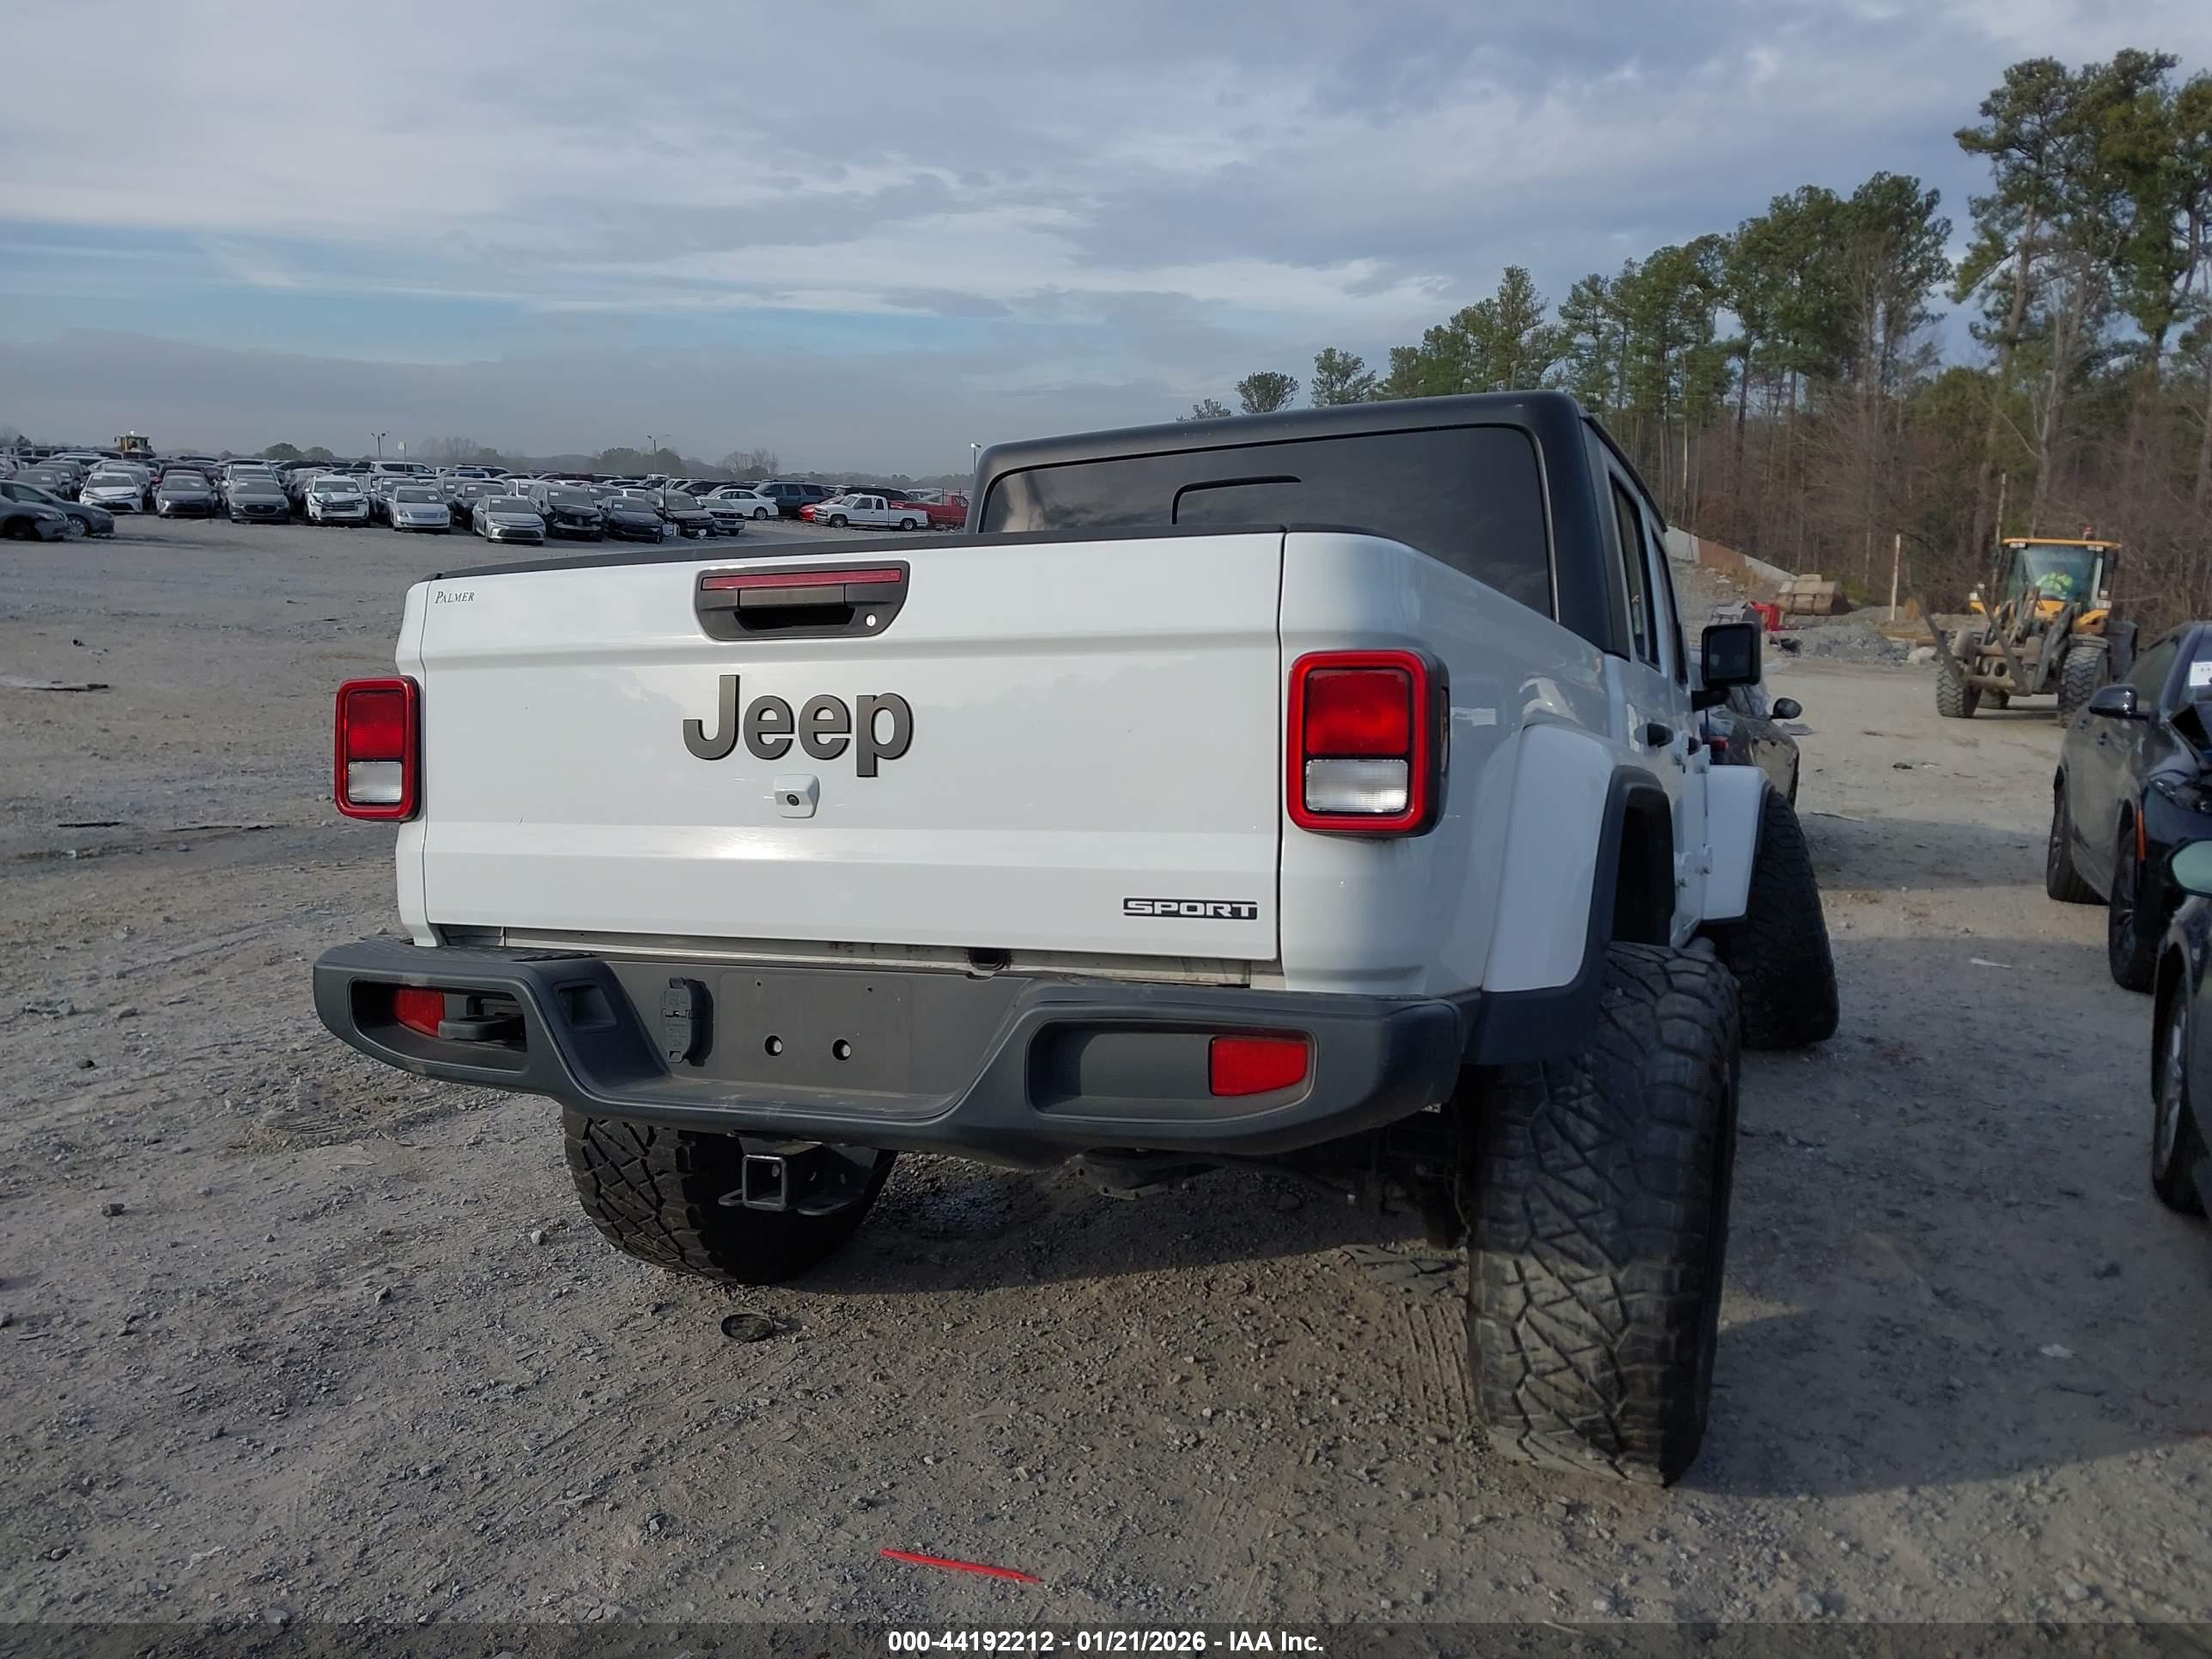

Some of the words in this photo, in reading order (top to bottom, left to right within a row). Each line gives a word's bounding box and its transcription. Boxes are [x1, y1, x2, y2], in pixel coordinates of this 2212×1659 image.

[434, 591, 475, 604] PALMER
[683, 674, 915, 777] Jeep
[1123, 900, 1258, 918] SPORT
